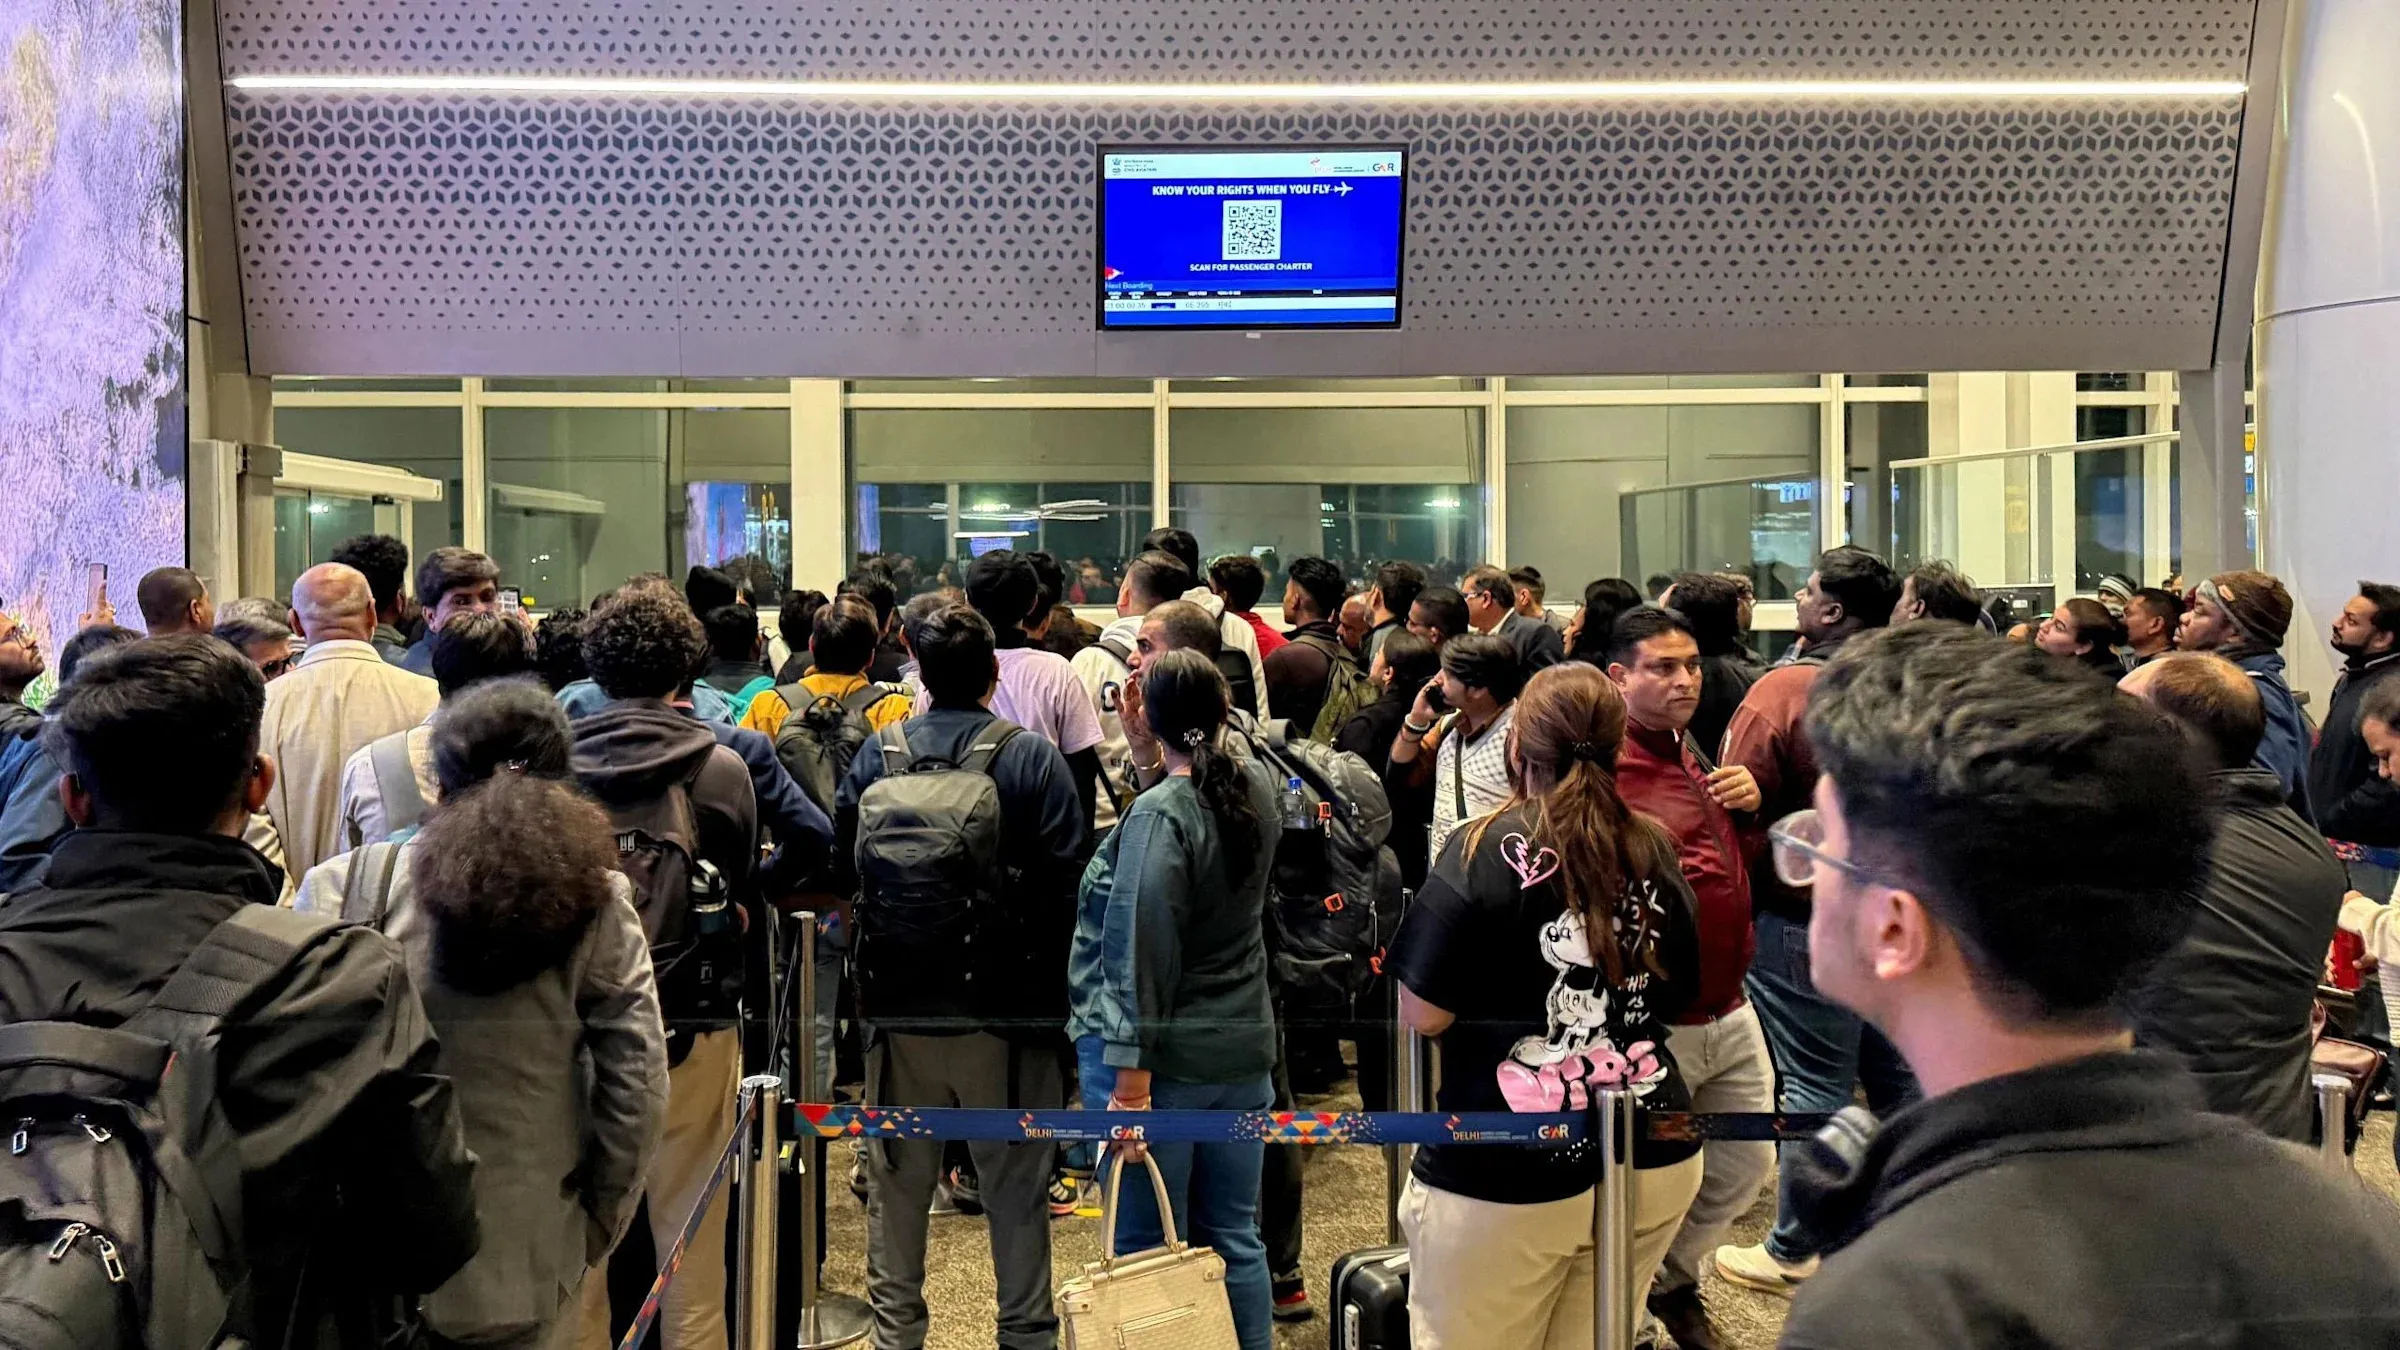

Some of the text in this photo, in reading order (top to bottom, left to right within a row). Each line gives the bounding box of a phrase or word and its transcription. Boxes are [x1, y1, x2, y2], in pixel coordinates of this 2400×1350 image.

[1152, 183, 1331, 196] KNOW YOUR RIGHTS WHEN YOU FLY
[1190, 262, 1313, 272] SCAN FOR PASSENGER CHARTER
[1105, 281, 1153, 291] Next Boarding
[1025, 1128, 1053, 1138] DELHI
[1453, 1131, 1481, 1141] DELHI
